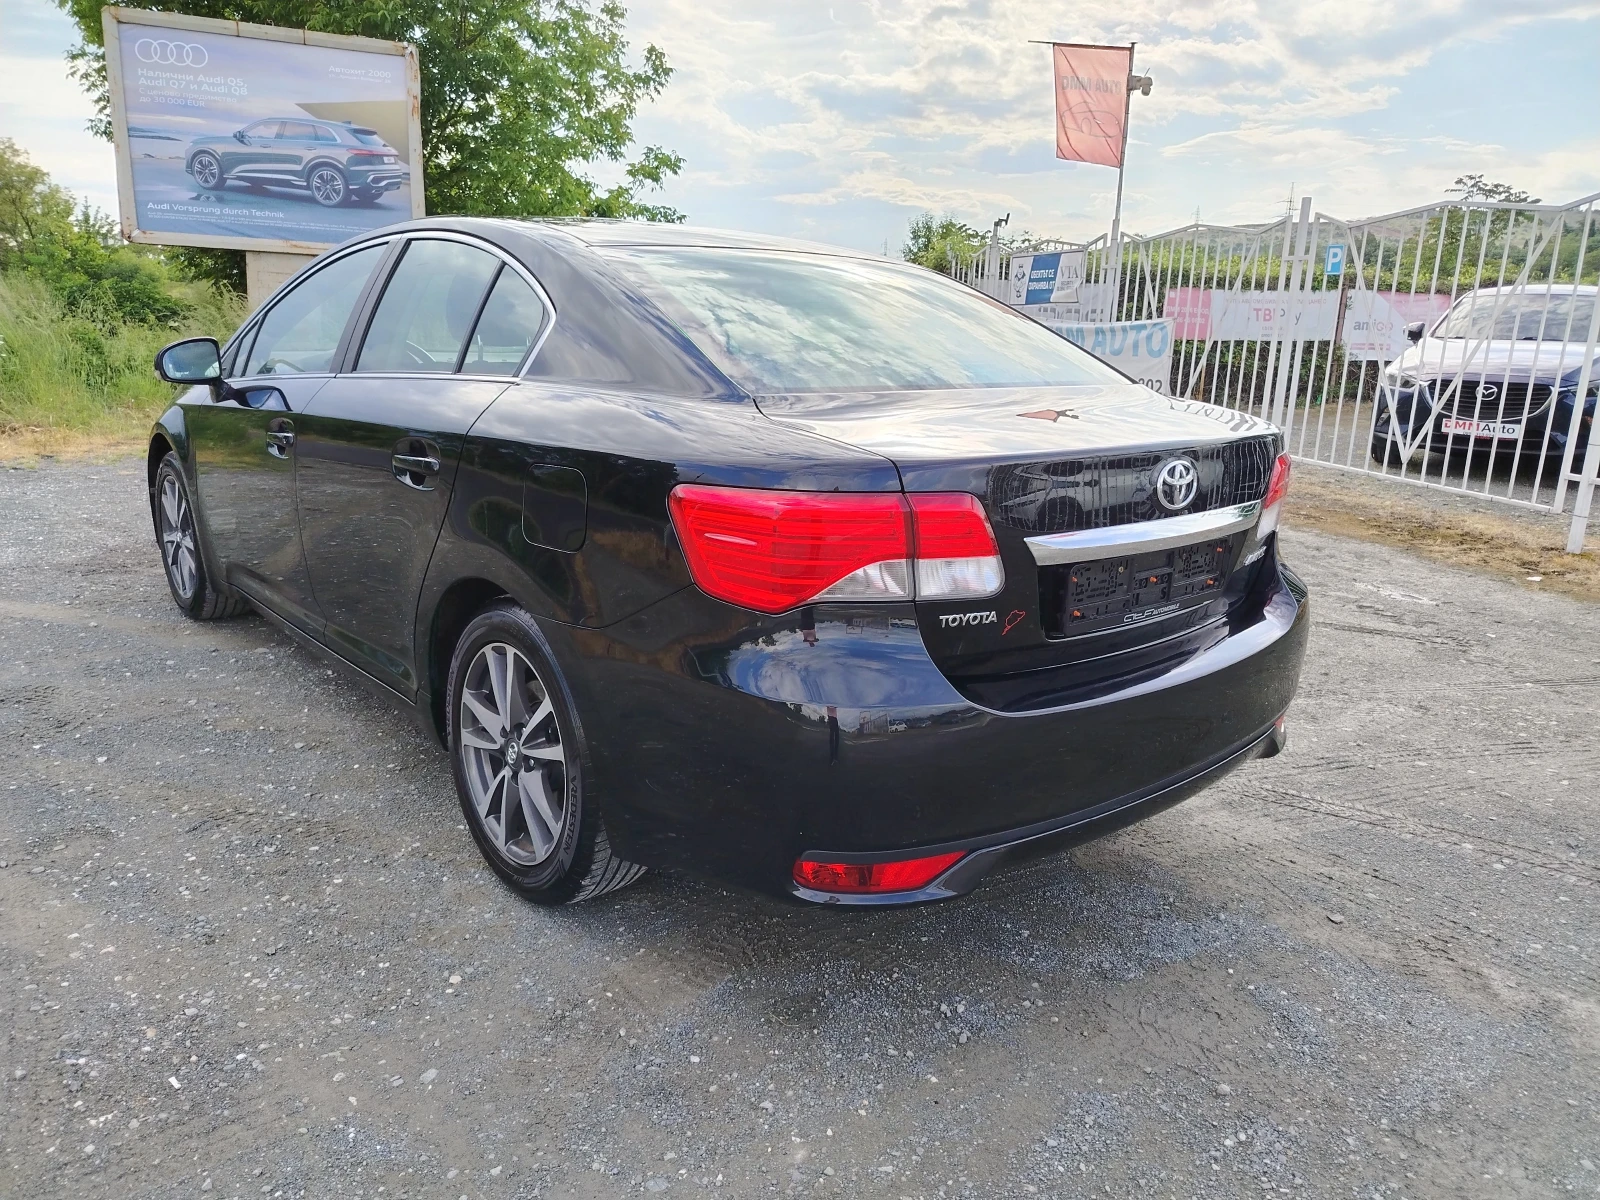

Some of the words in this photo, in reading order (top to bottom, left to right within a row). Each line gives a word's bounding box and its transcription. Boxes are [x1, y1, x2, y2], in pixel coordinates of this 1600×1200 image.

[138, 68, 194, 81] Налични
[197, 74, 224, 84] Audi
[227, 77, 248, 88] Q5,
[328, 65, 366, 76] Автохит
[368, 69, 392, 78] 2000
[138, 77, 166, 87] Audi
[169, 80, 186, 89] Q7
[201, 83, 228, 93] Audi
[231, 86, 248, 96] Q8
[147, 89, 181, 98] ценово
[183, 92, 237, 103] предимство
[153, 96, 165, 104] 30
[167, 97, 185, 105] 000
[187, 99, 206, 108] EUR
[147, 202, 170, 210] Audi
[171, 203, 220, 215] Vorsprung
[222, 206, 249, 216] durch
[251, 209, 285, 218] Technik
[1327, 248, 1342, 271] P
[1048, 269, 1055, 278] СЕ
[1091, 322, 1169, 359] AUTO
[939, 611, 997, 628] TOYOTA
[563, 775, 578, 855] VREDESTEIN
